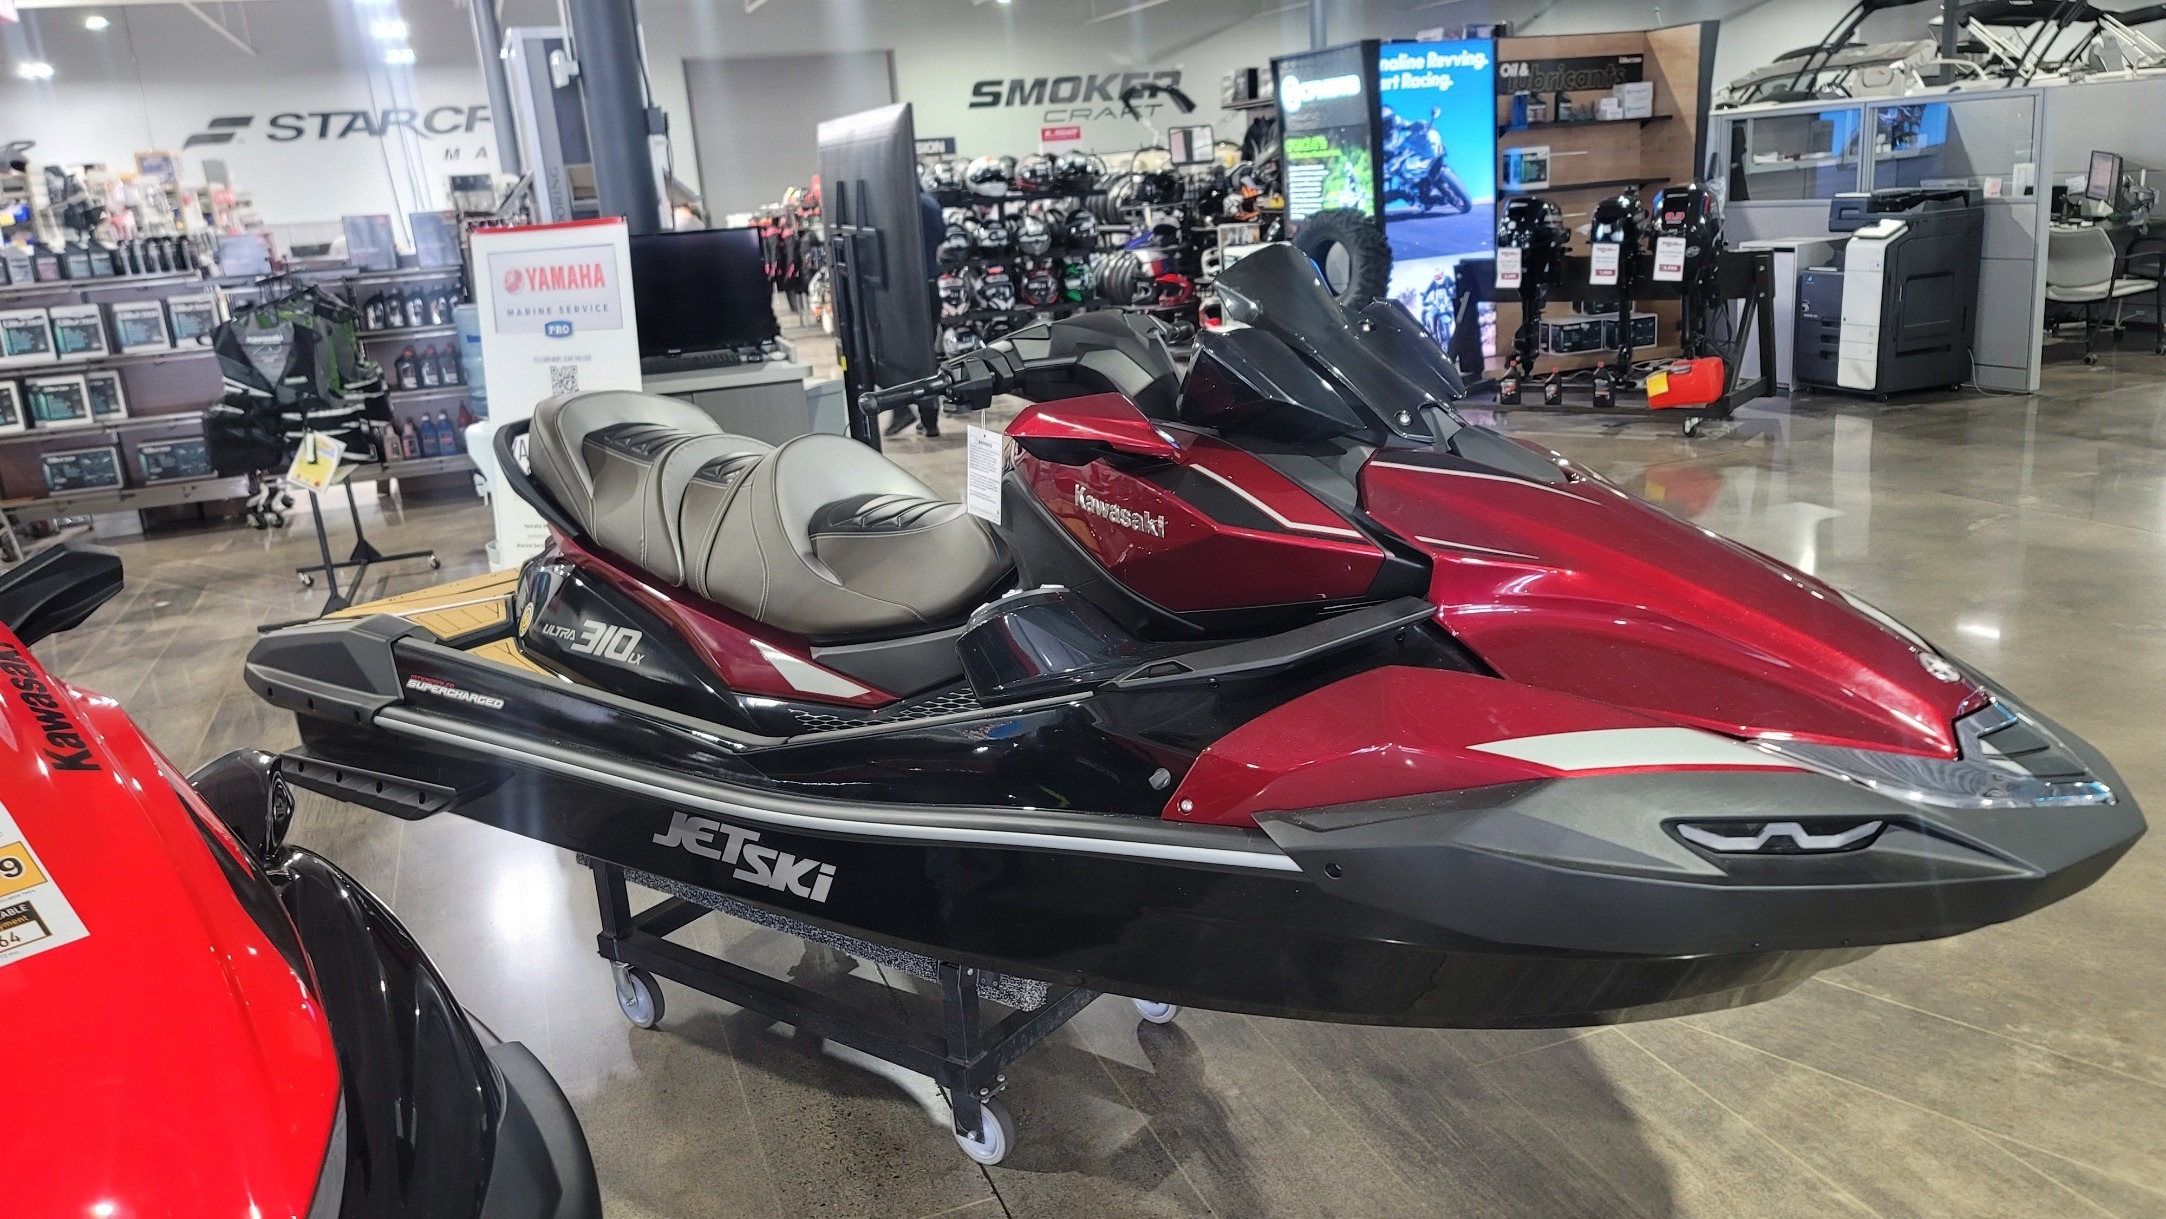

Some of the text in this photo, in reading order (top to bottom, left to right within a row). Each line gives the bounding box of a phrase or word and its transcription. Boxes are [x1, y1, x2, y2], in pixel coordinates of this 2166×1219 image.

[1500, 61, 1530, 78] Oil &
[1508, 62, 1627, 93] lubricants
[968, 71, 1182, 109] SMOKER
[1043, 103, 1164, 124] CRAFT
[525, 262, 606, 292] YAMAHA
[507, 304, 609, 317] MARINE SERVICE
[548, 324, 571, 335] PRO
[1074, 483, 1165, 539] Kawasaki
[542, 622, 577, 641] ULTRA
[570, 619, 643, 663] 310
[406, 678, 505, 710] SUPERCHARGED
[0, 903, 30, 919] ABLE
